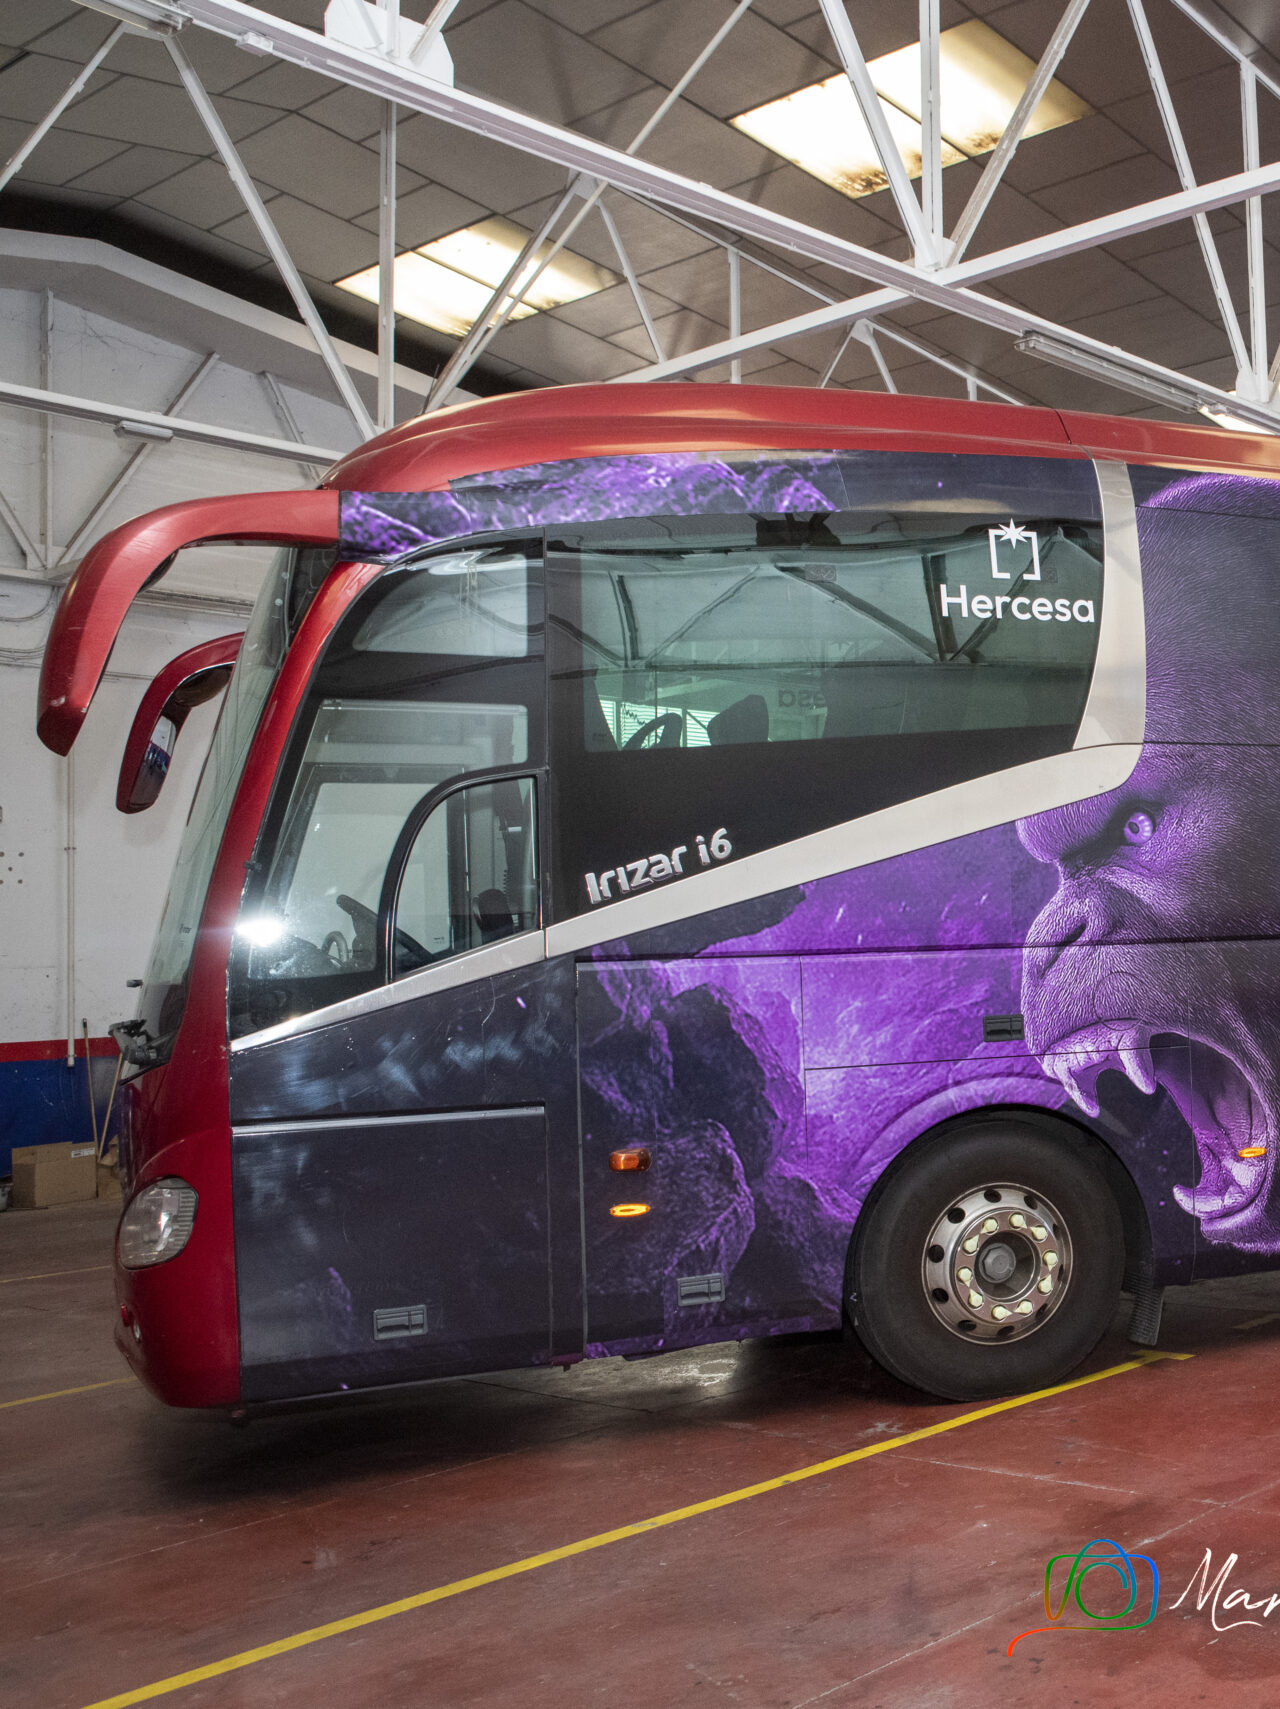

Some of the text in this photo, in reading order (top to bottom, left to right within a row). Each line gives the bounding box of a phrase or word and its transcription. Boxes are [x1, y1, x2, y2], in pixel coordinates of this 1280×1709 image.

[940, 584, 1095, 623] Hercesa
[585, 828, 733, 904] Irizar i6
